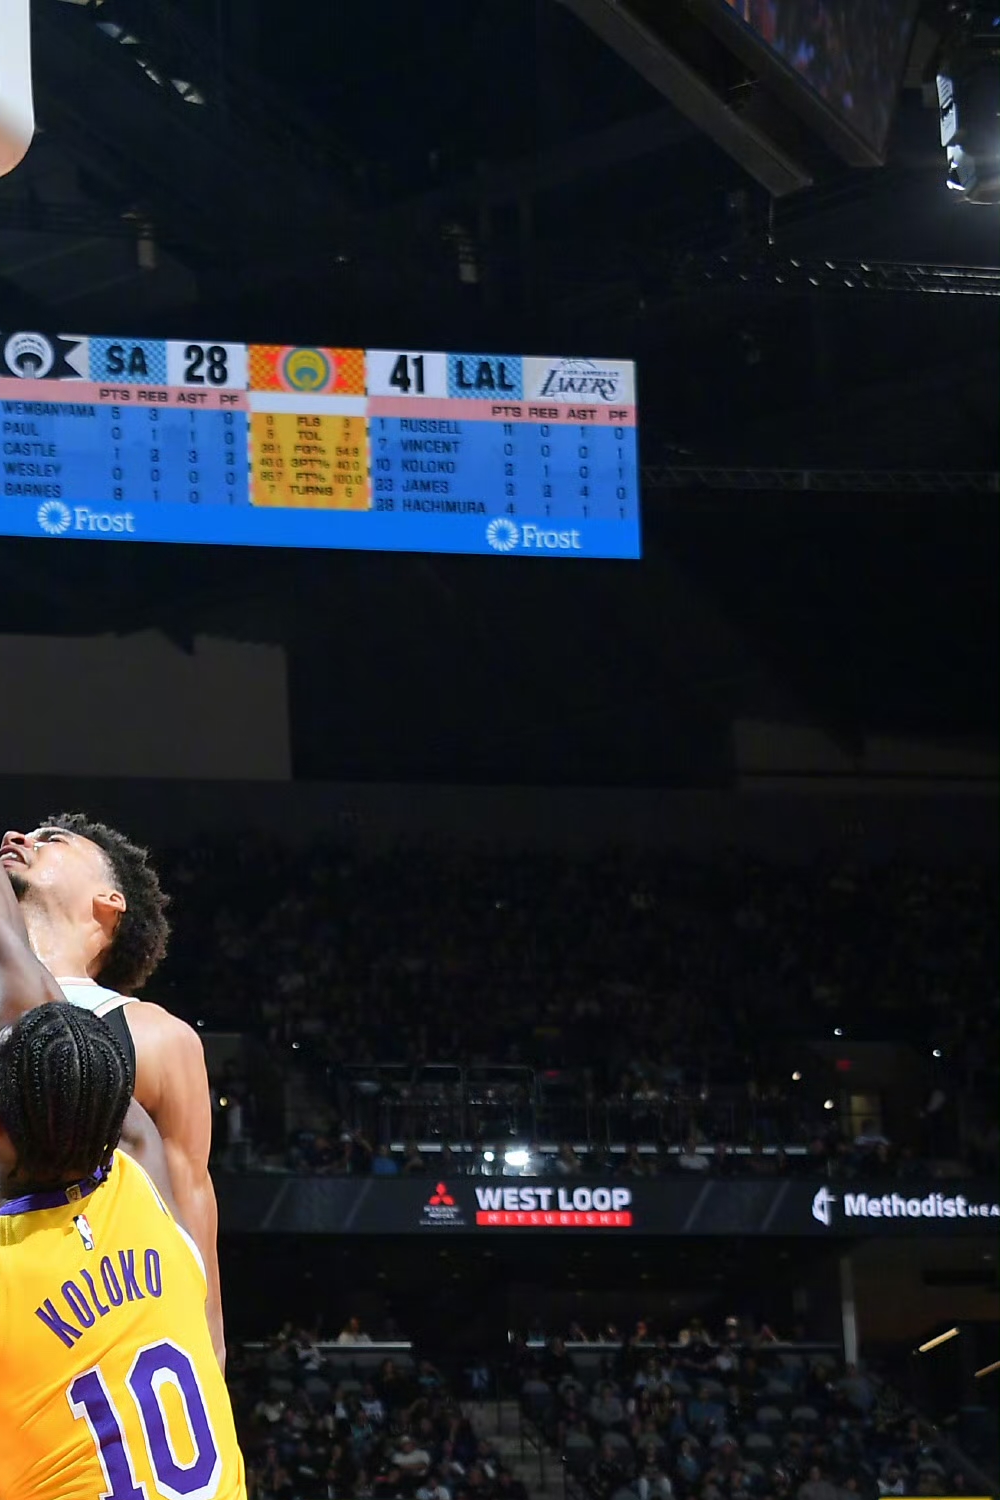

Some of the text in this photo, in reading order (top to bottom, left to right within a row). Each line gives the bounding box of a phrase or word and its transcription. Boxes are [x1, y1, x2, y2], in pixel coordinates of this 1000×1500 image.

[106, 345, 228, 386] SA 28
[390, 355, 515, 394] 41 LAL
[537, 369, 618, 401] LAKERS
[100, 389, 238, 404] PTS REB AST PF
[492, 406, 628, 420] PTS REB AST PF
[3, 422, 38, 436] PAUL
[400, 420, 462, 434] RUSSELL
[3, 442, 56, 457] CASTLE
[401, 440, 461, 453] VINCENT
[3, 462, 62, 477] WESLEY
[376, 459, 391, 472] 10
[401, 459, 456, 474] KOLOKO
[5, 482, 61, 498] BARNES
[402, 480, 449, 494] JAMES
[402, 499, 486, 514] HACHIMURA
[73, 508, 135, 532] Frost
[521, 525, 581, 550] Frost
[475, 1187, 631, 1211] WEST LOOP
[844, 1192, 967, 1217] Methodist
[488, 1213, 623, 1225] MITSUBISHI
[34, 1248, 163, 1349] KOLOKO
